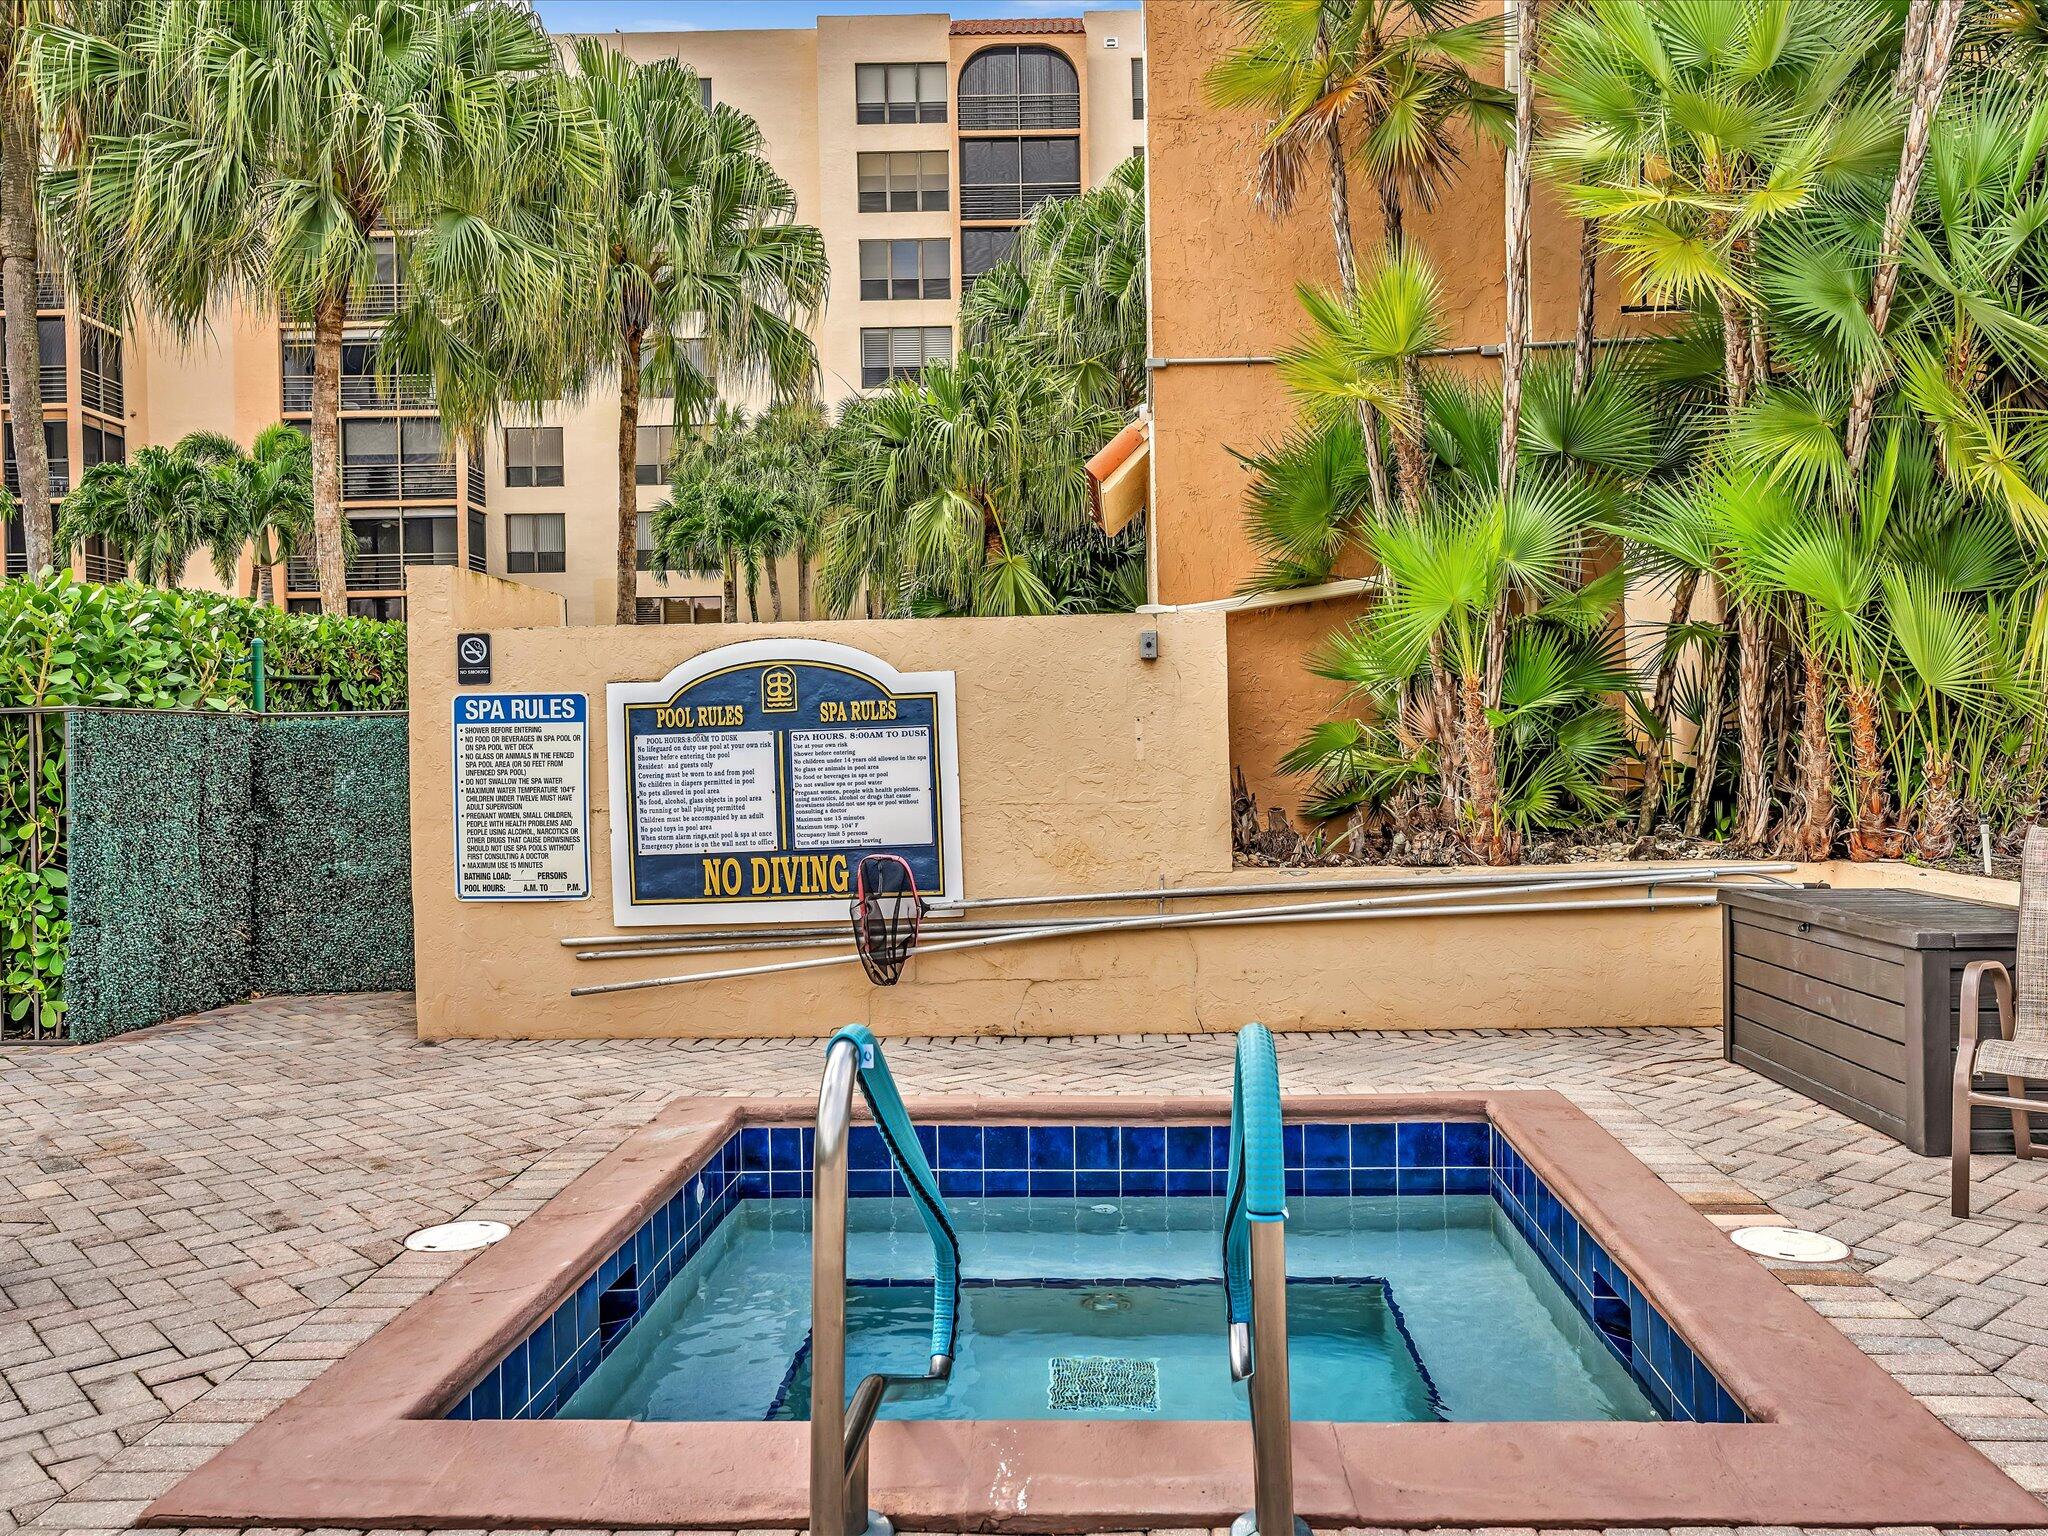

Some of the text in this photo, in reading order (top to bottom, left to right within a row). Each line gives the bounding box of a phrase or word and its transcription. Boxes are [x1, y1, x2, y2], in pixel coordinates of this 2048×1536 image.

[465, 698, 576, 720] SPA RULES
[656, 705, 744, 728] POOL RULES
[820, 700, 897, 723] SPA RULES
[493, 872, 511, 880] LOAD:
[703, 855, 850, 896] NO DIVING
[465, 884, 480, 892] POOL
[483, 884, 506, 892] HOURS:
[567, 883, 580, 891] P.M.
